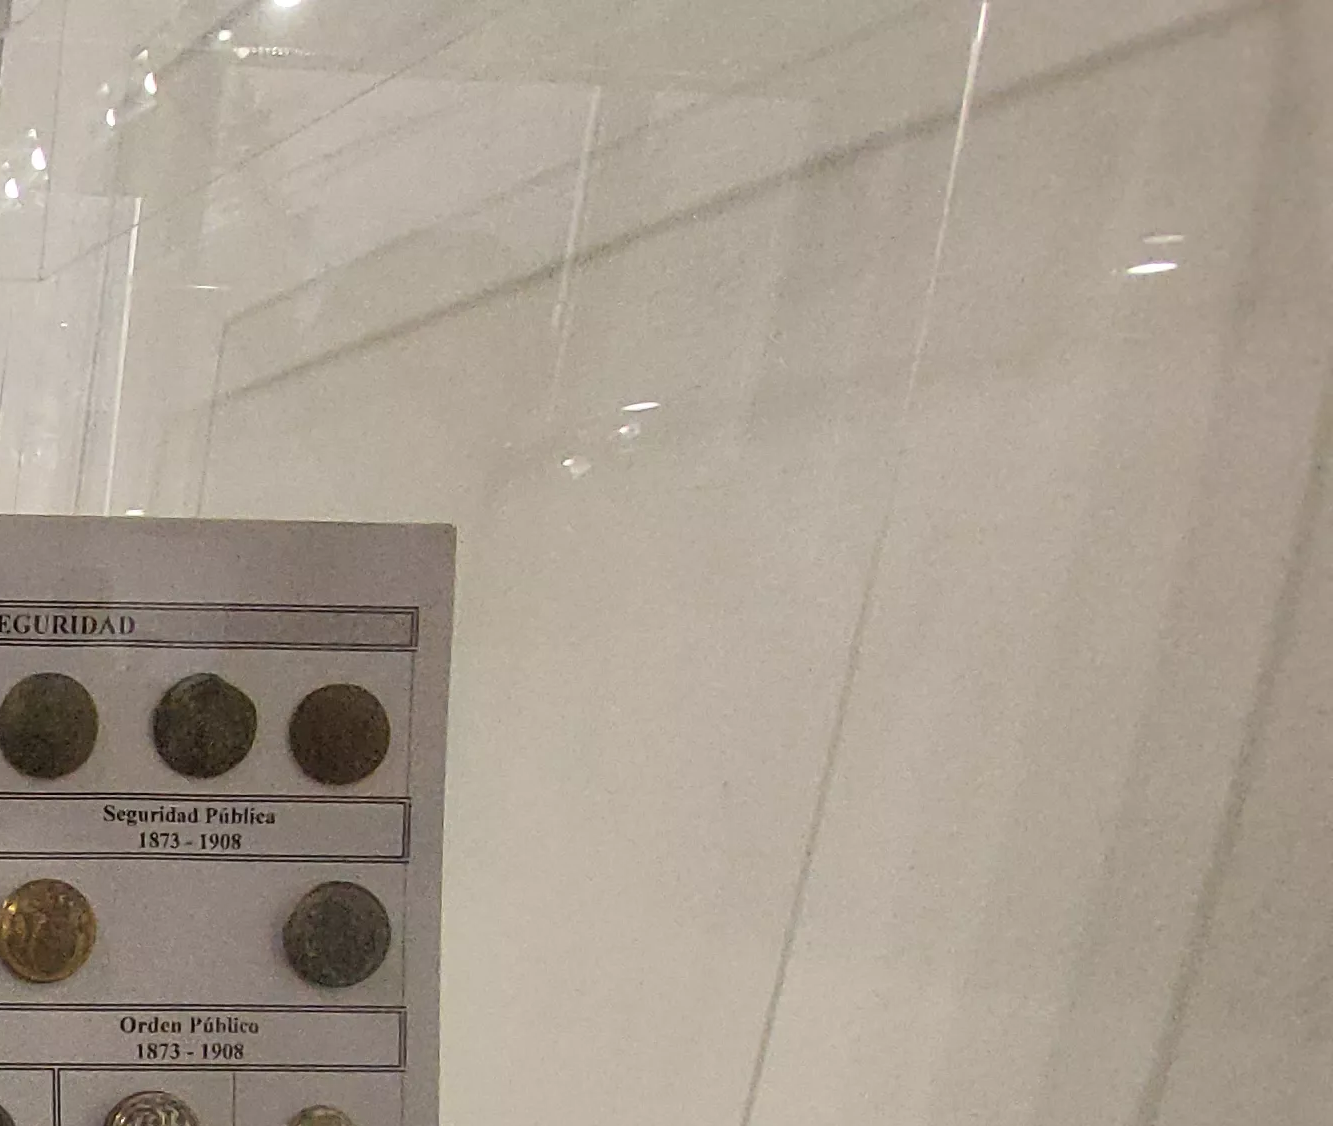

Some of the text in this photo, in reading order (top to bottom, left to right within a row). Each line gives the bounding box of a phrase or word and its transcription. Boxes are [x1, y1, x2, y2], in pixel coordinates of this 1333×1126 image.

[103, 804, 276, 827] Seguridad Pública
[139, 831, 181, 849] 1873
[200, 833, 242, 850] 1908
[119, 1016, 259, 1034] Orden Público
[137, 1042, 181, 1060] 1873
[202, 1042, 244, 1060] 1908
